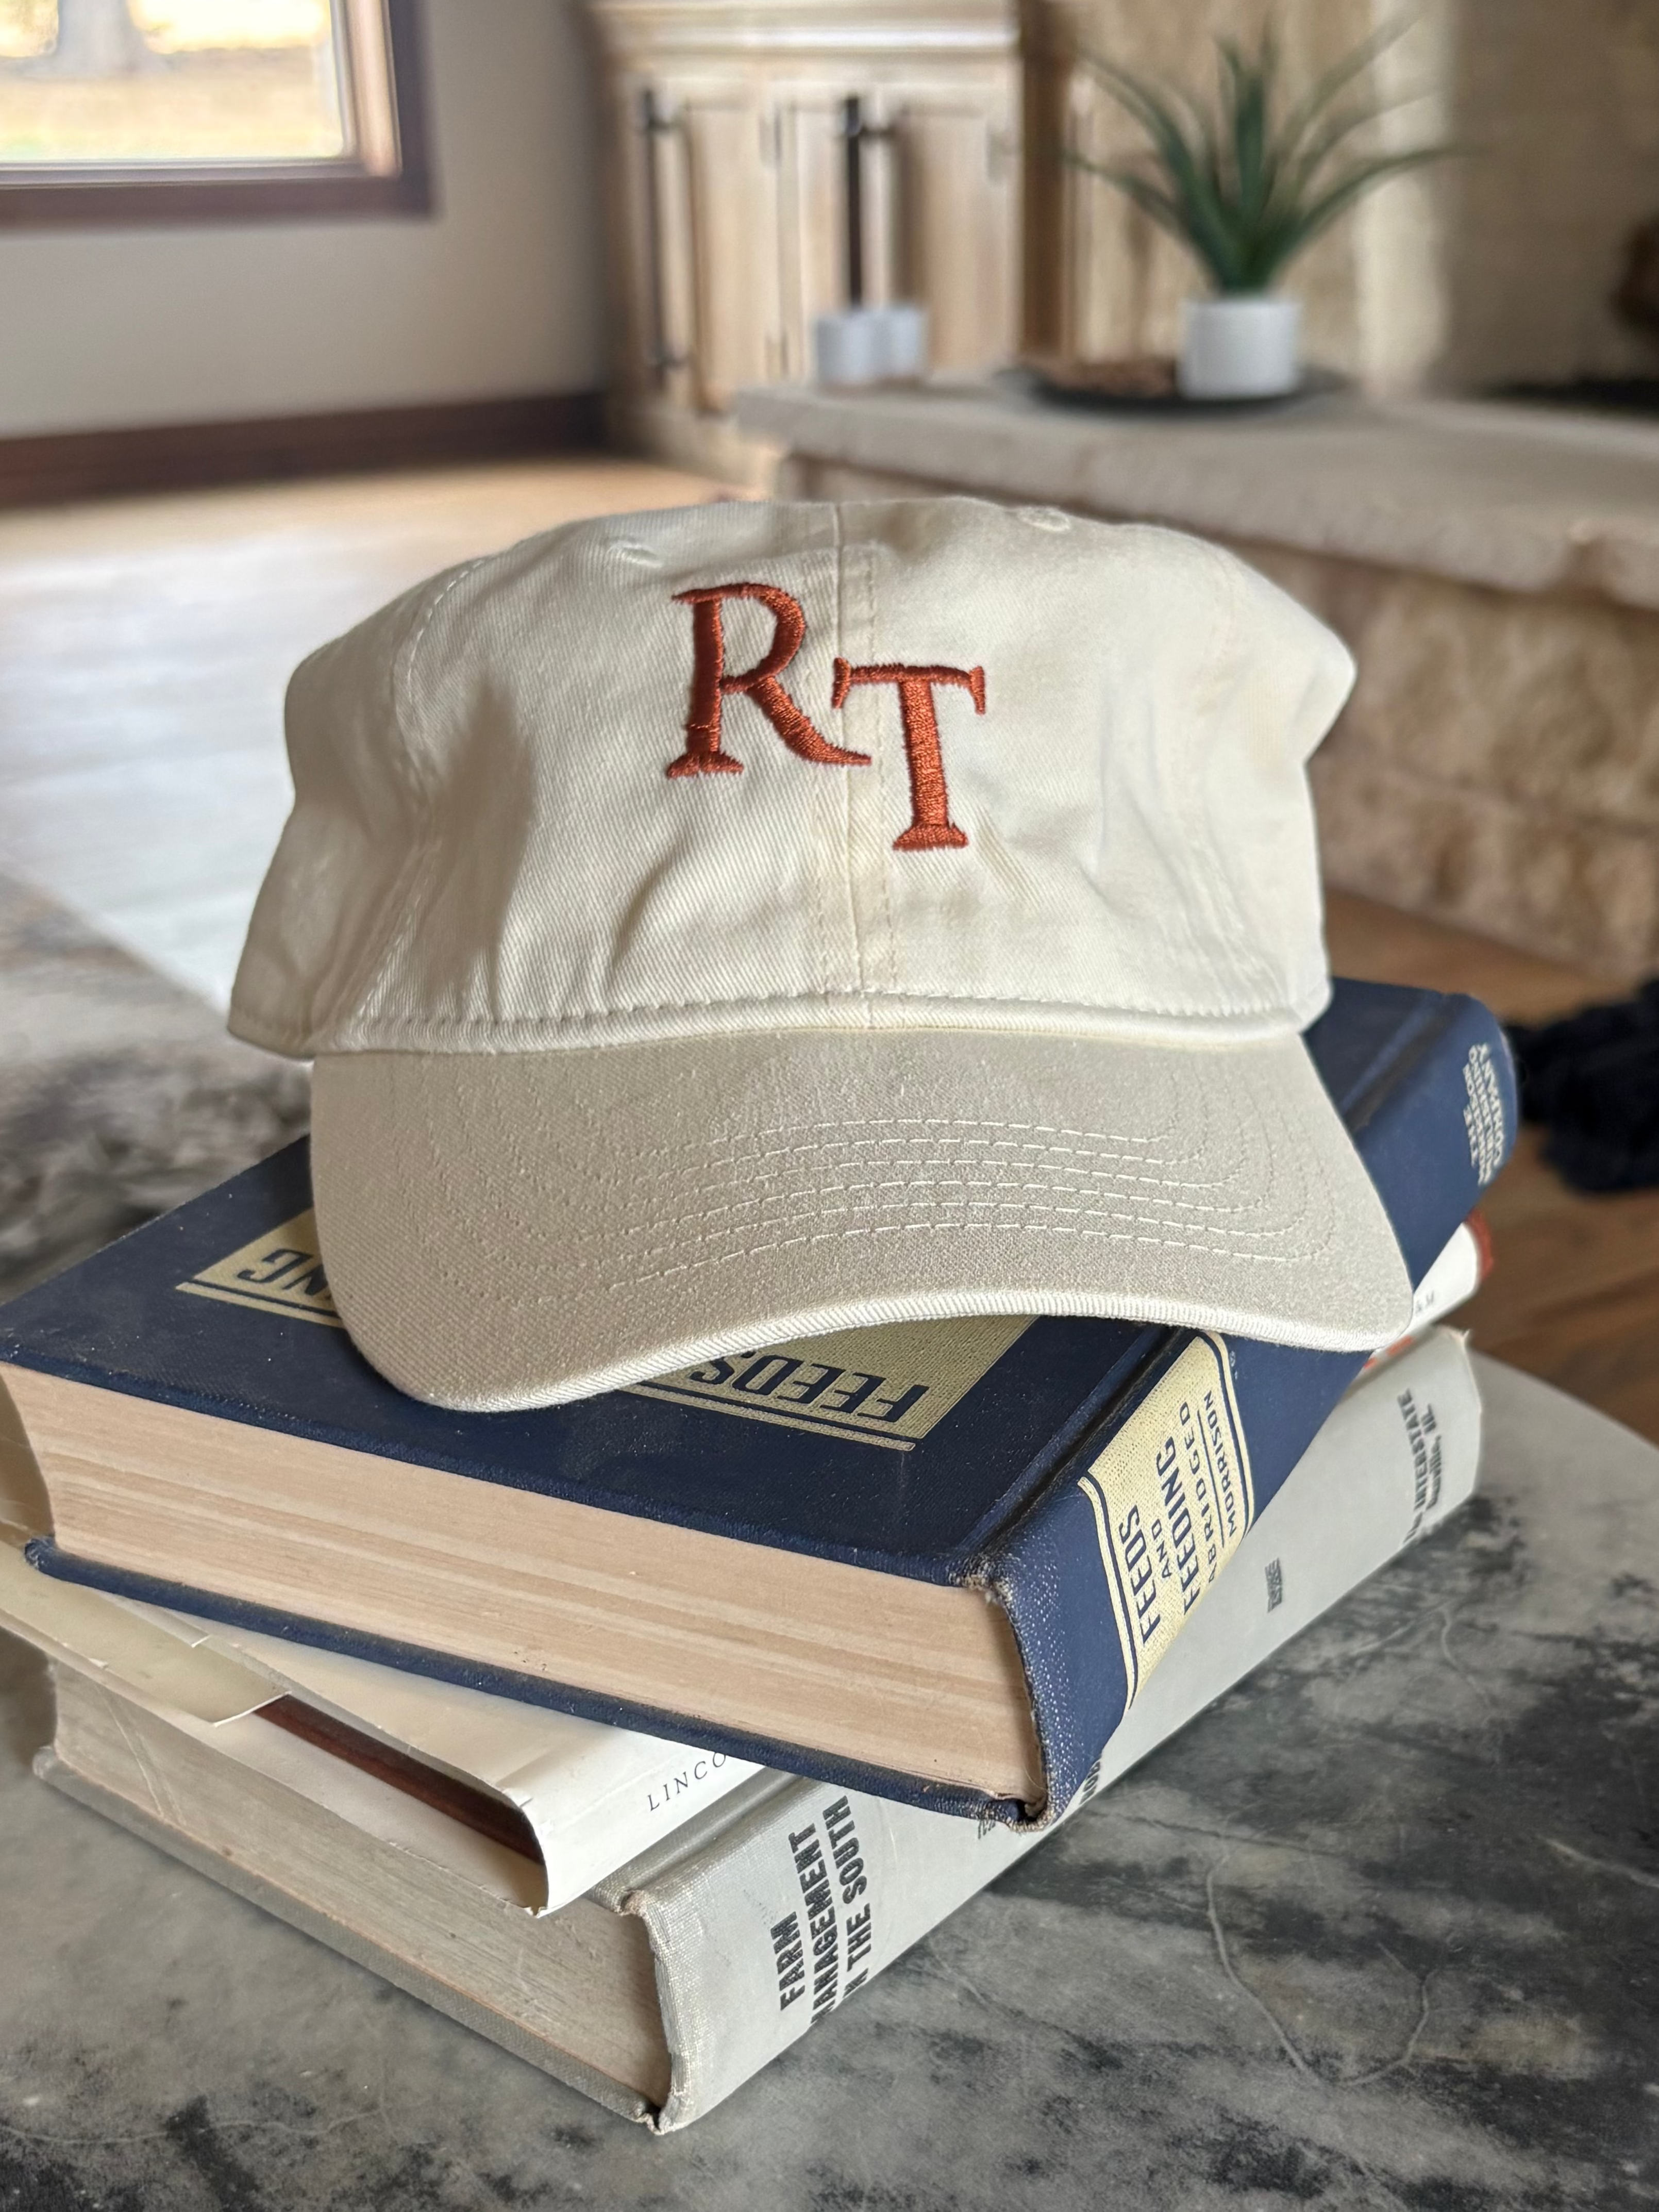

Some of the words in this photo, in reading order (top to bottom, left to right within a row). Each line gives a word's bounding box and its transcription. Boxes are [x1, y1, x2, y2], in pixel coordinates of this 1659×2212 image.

[666, 581, 985, 851] RT
[1204, 1390, 1237, 1537] MORRISON
[1119, 1504, 1161, 1644] FEEDS
[1151, 1518, 1172, 1579] AND
[1156, 1436, 1200, 1616] FEEDING
[823, 1795, 868, 1904] SOUTH
[770, 1911, 806, 2011] FARM
[846, 1903, 872, 1972] THE
